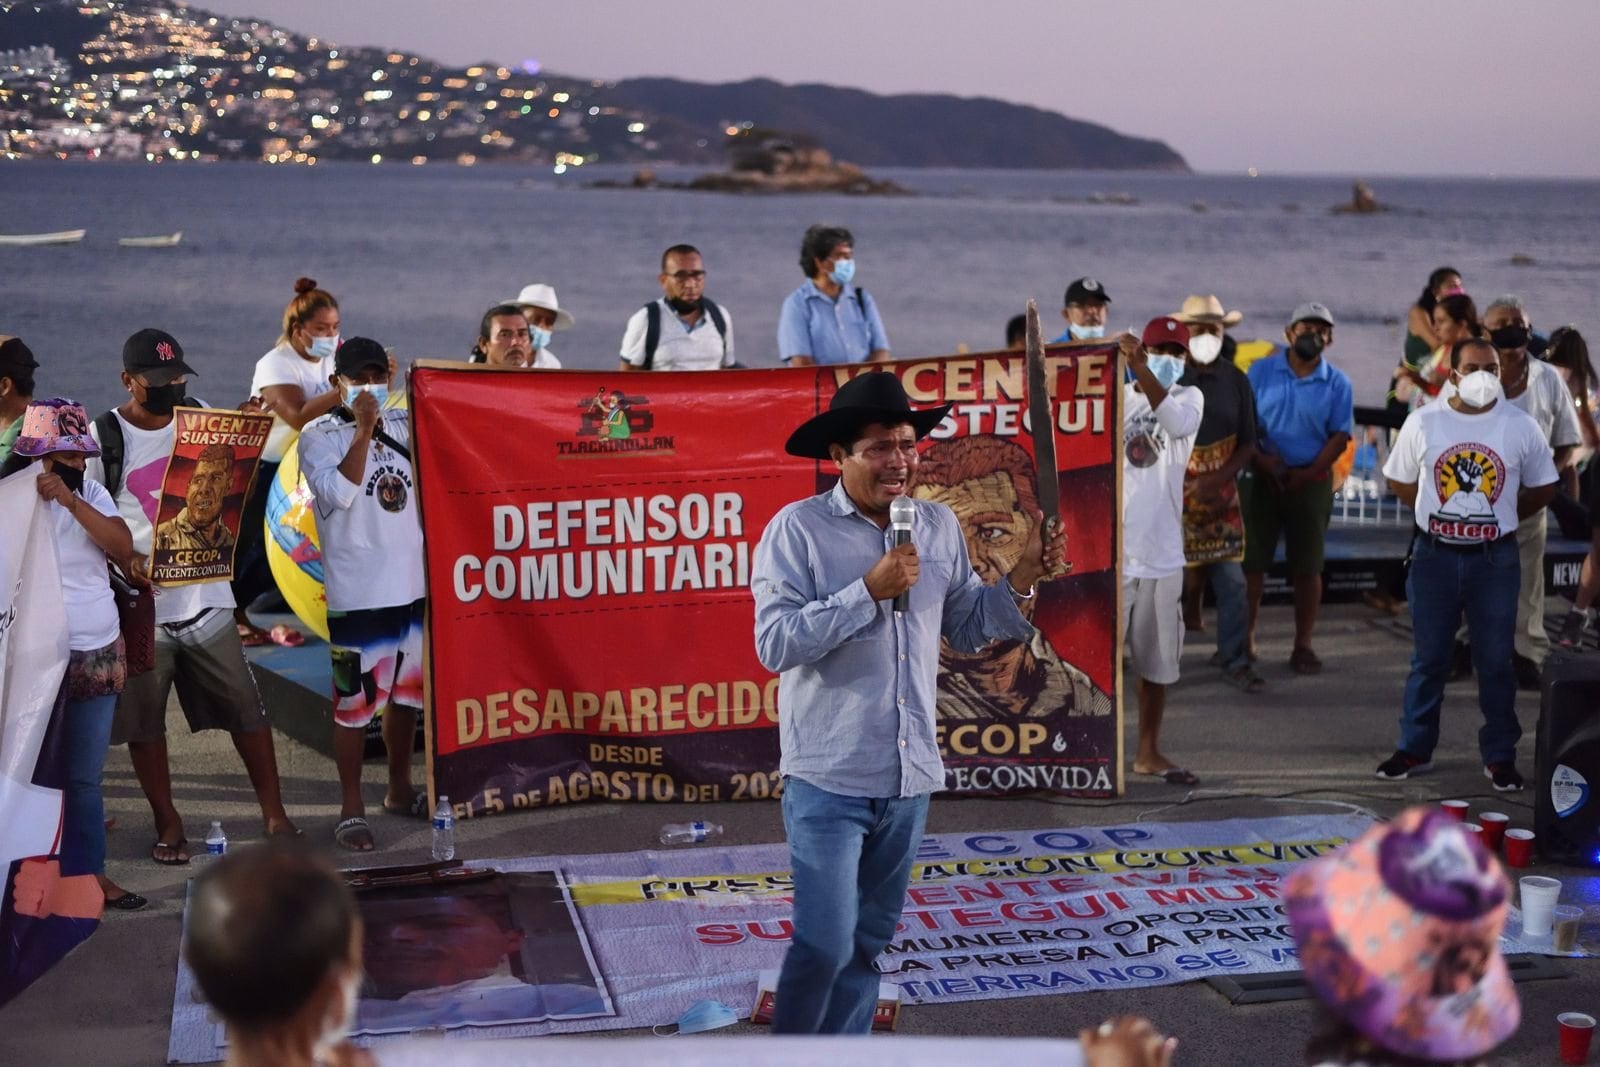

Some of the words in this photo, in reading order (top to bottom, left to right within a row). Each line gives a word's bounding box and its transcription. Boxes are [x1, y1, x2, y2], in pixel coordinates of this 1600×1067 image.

[834, 354, 1108, 403] CENTE
[180, 431, 264, 447] SUASTEGUI
[183, 413, 271, 435] VICENTE
[492, 491, 743, 552] DEFENSOR
[153, 563, 231, 579] #VICENTECONVIDA
[175, 549, 218, 564] CECOP
[453, 541, 750, 603] COMUNITARI
[935, 723, 1047, 755] ECOP
[589, 743, 663, 767] DESDE
[484, 787, 505, 815] 5
[512, 790, 541, 809] DE
[548, 770, 675, 805] AGOSTO
[730, 770, 785, 801] 202
[944, 765, 1112, 791] ECONVIDA
[916, 829, 1154, 859] ECOP
[1113, 850, 1244, 869] CON
[906, 876, 1101, 907] ENTE
[882, 928, 1091, 955] MUNERO
[1103, 904, 1286, 938] OPOSIT
[940, 945, 1111, 971] PRESA
[1113, 934, 1181, 958] LA
[899, 970, 1085, 997] TIERRA
[1086, 965, 1165, 984] NO
[1175, 949, 1247, 971] SE
